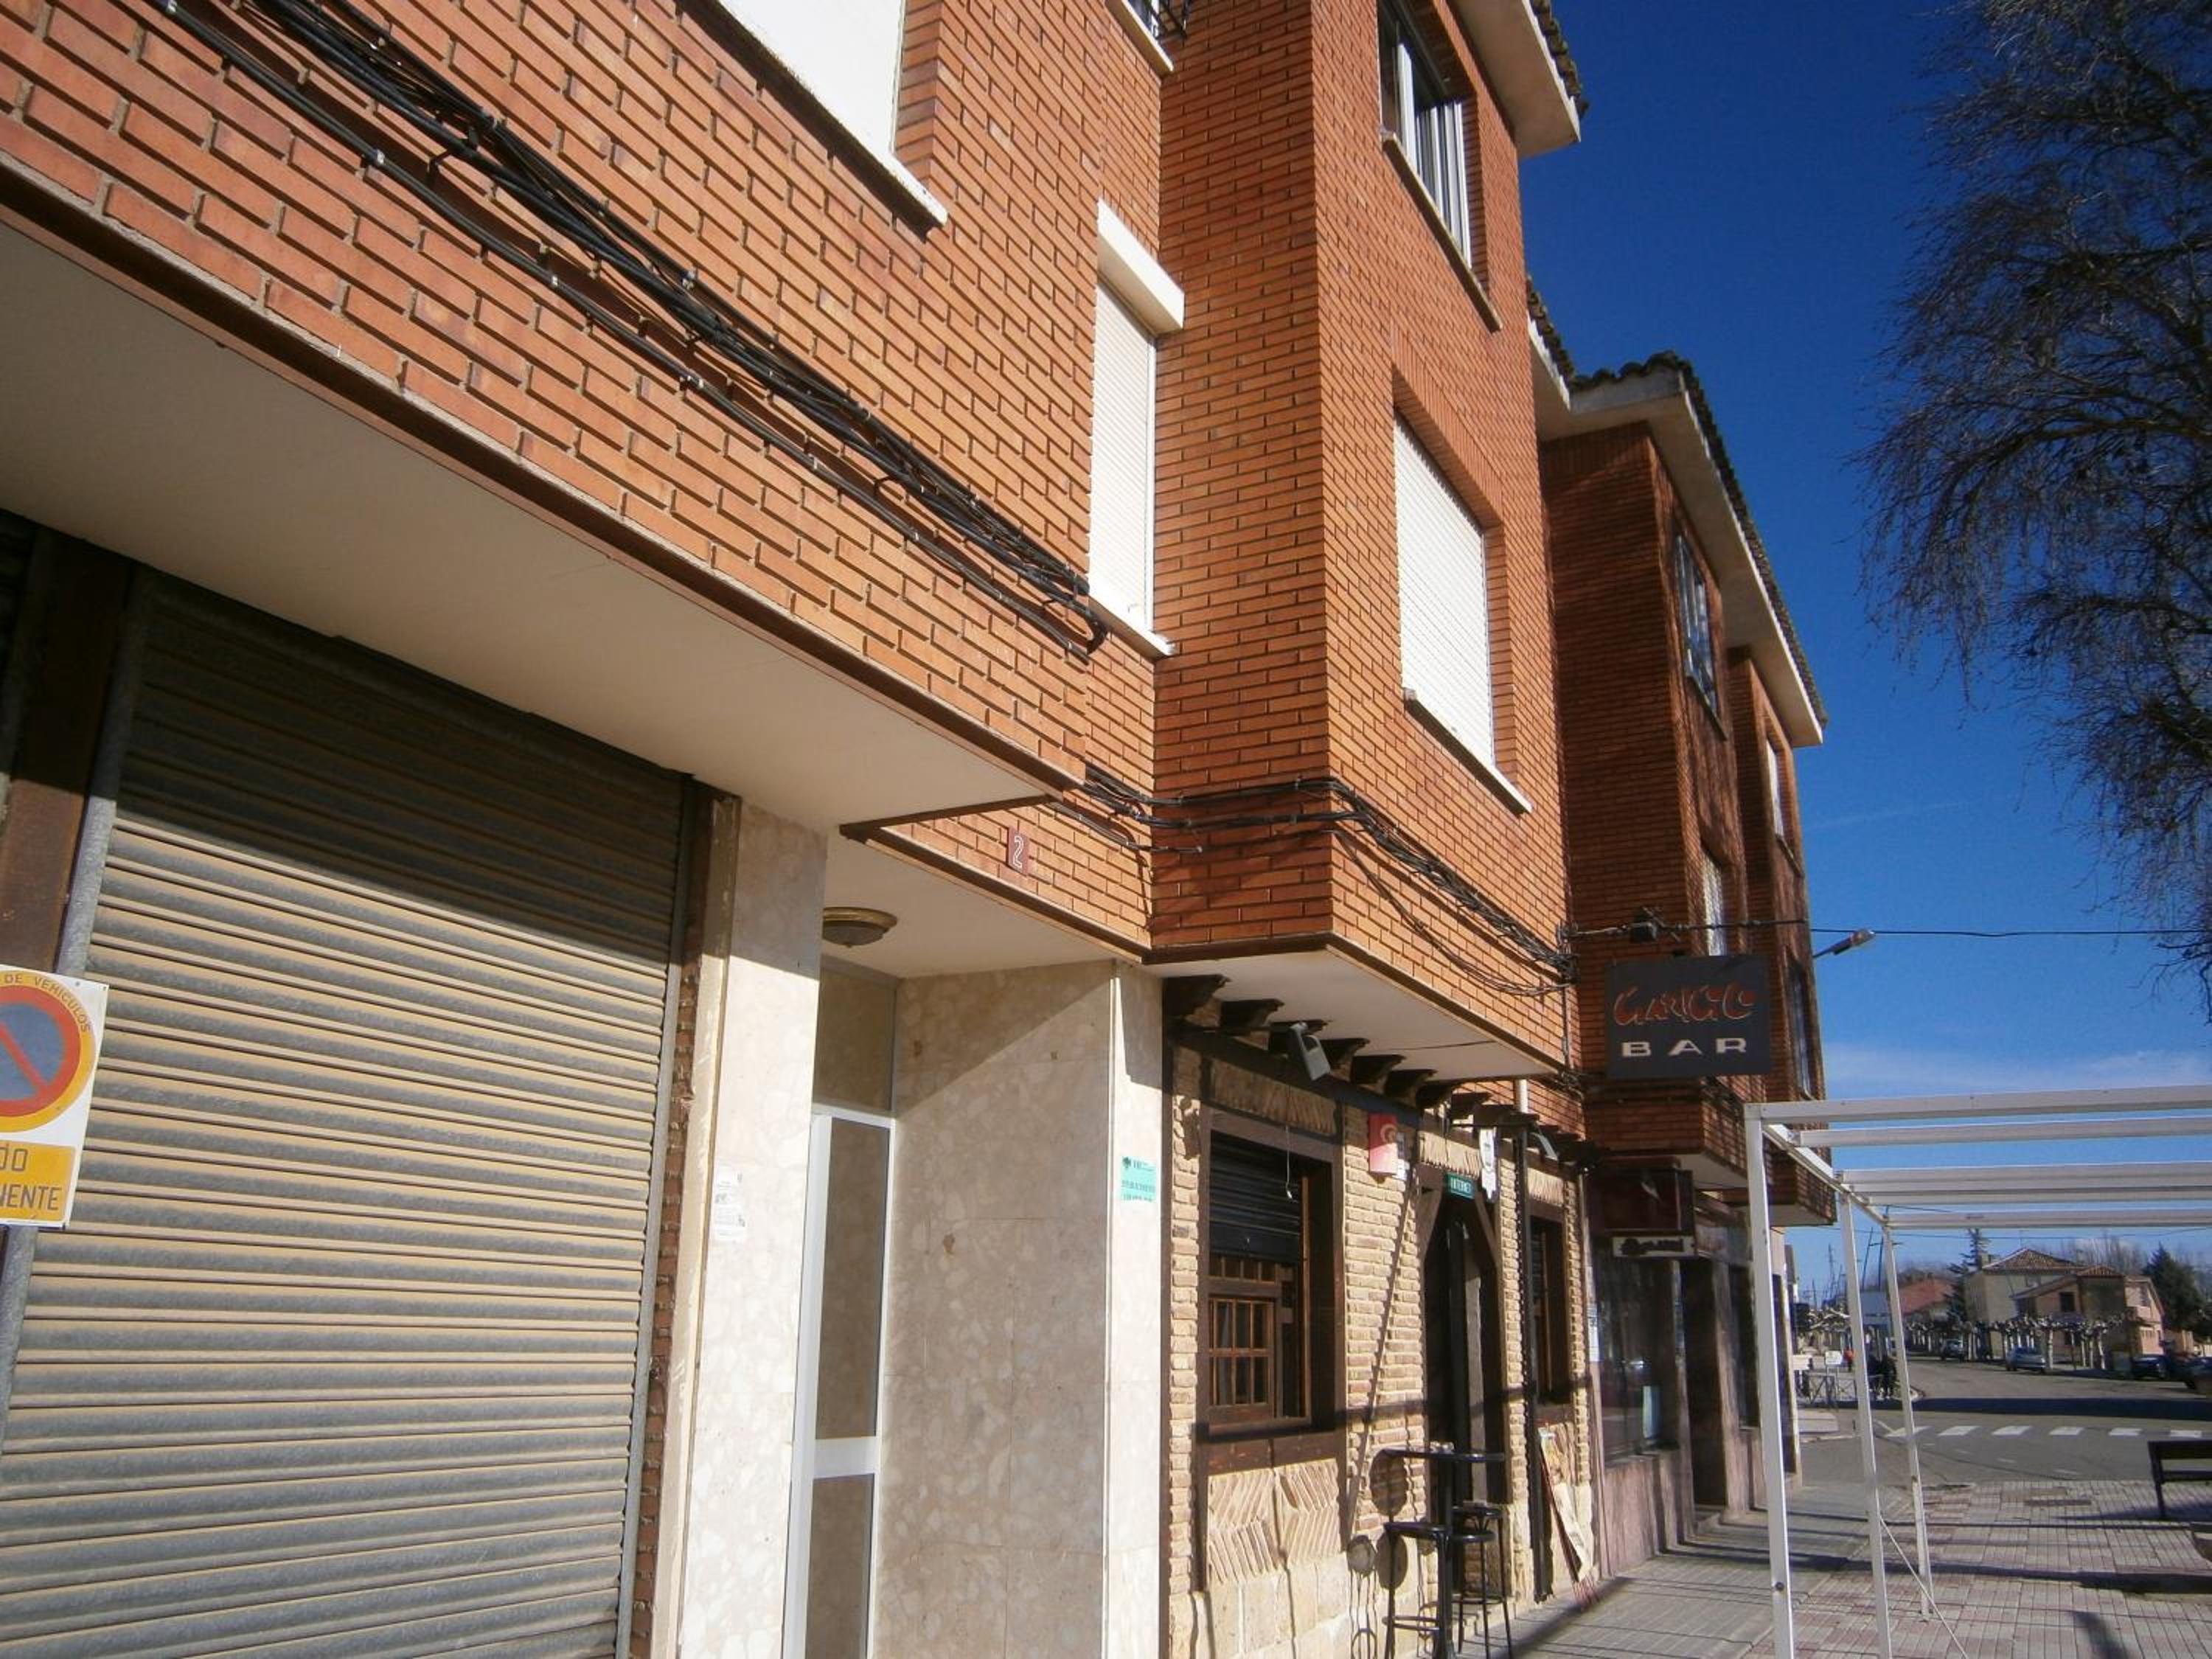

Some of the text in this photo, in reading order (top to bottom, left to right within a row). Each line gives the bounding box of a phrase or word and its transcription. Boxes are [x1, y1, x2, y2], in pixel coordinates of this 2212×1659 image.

[1012, 835, 1024, 869] 2
[4, 973, 93, 1032] DE VEHICULOS
[1621, 1037, 1747, 1058] BAR
